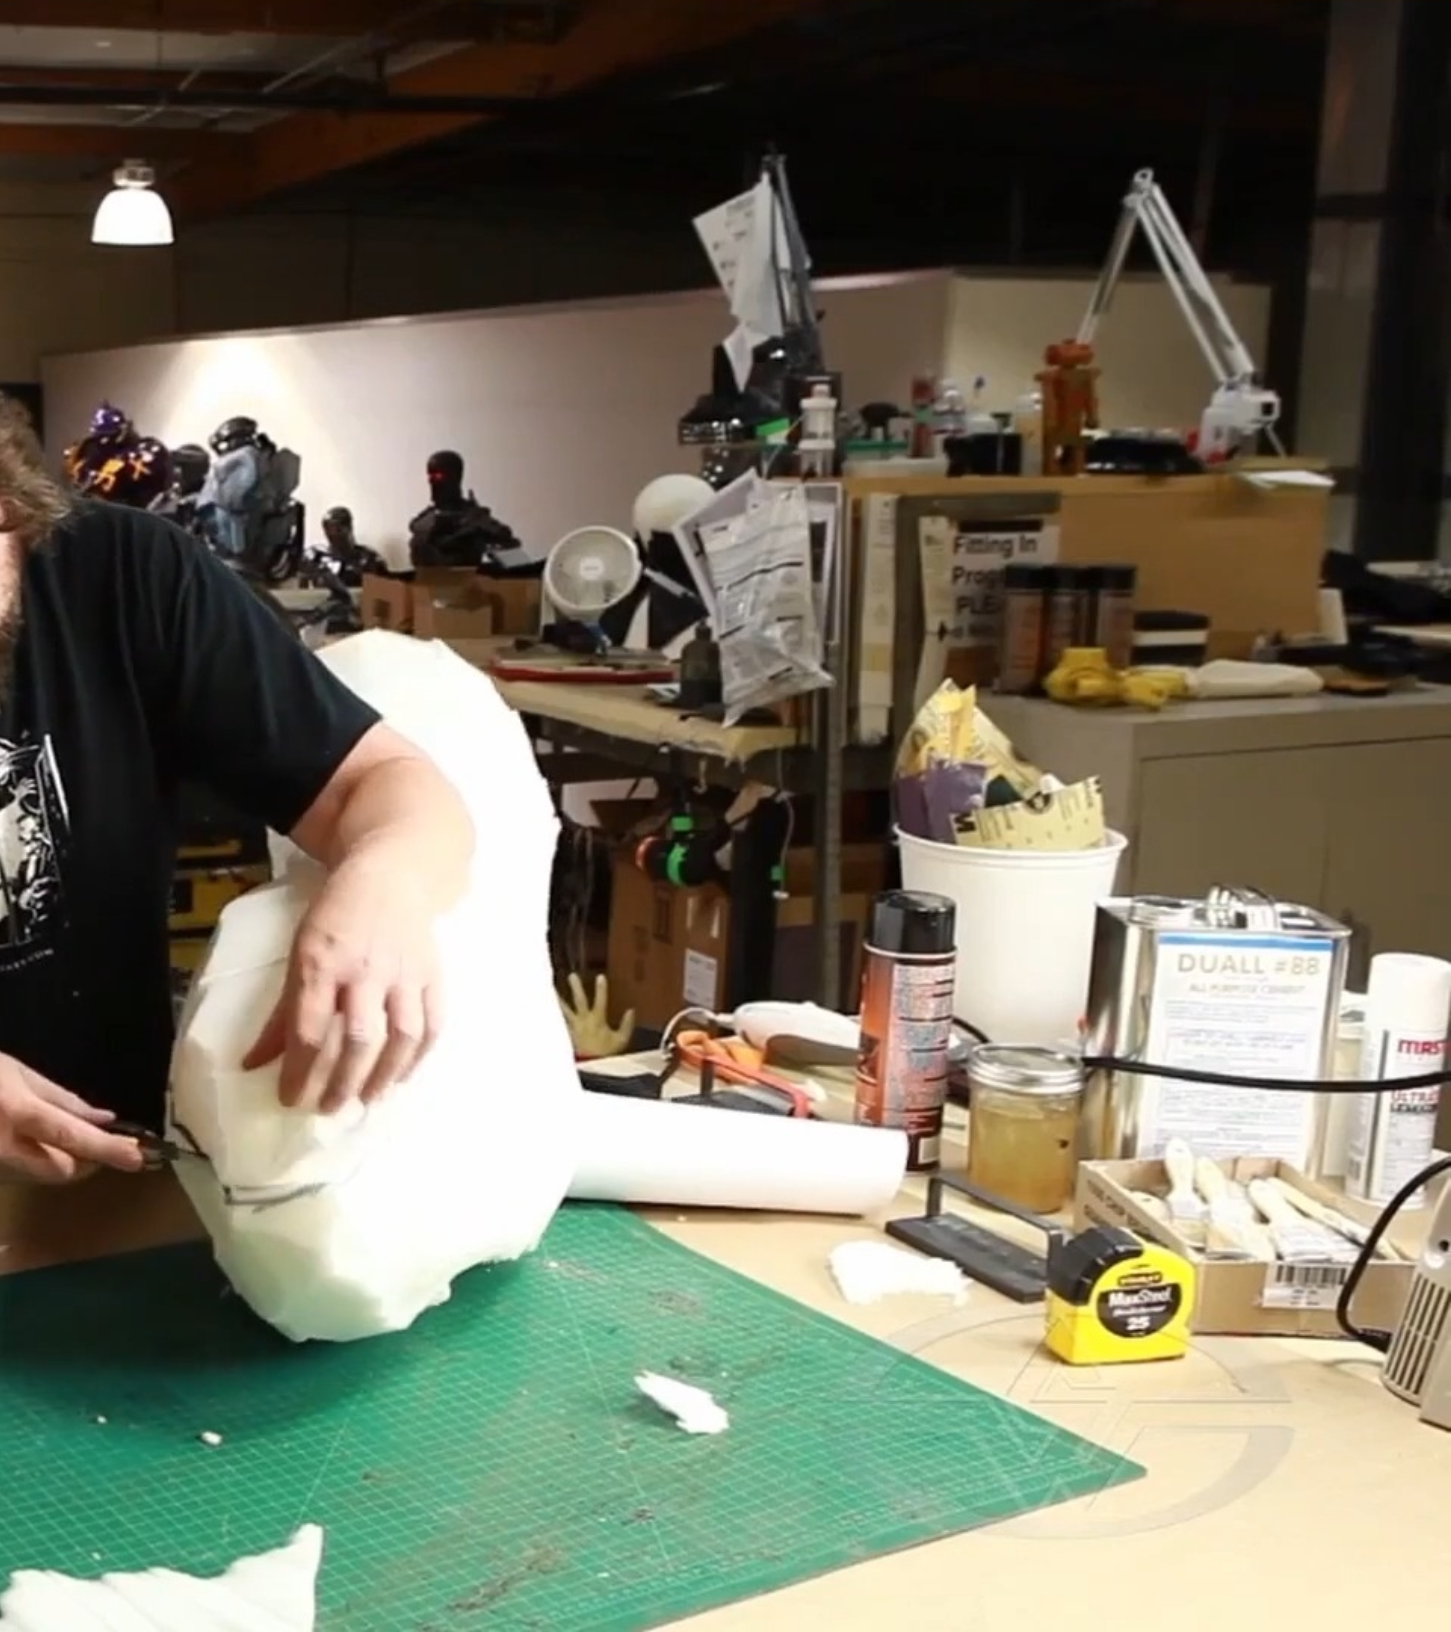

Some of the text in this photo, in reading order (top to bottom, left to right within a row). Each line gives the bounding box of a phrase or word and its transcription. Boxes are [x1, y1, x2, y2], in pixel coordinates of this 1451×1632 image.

[952, 565, 1003, 589] Prog
[1177, 953, 1266, 974] DUALL
[1126, 1315, 1151, 1331] 25
